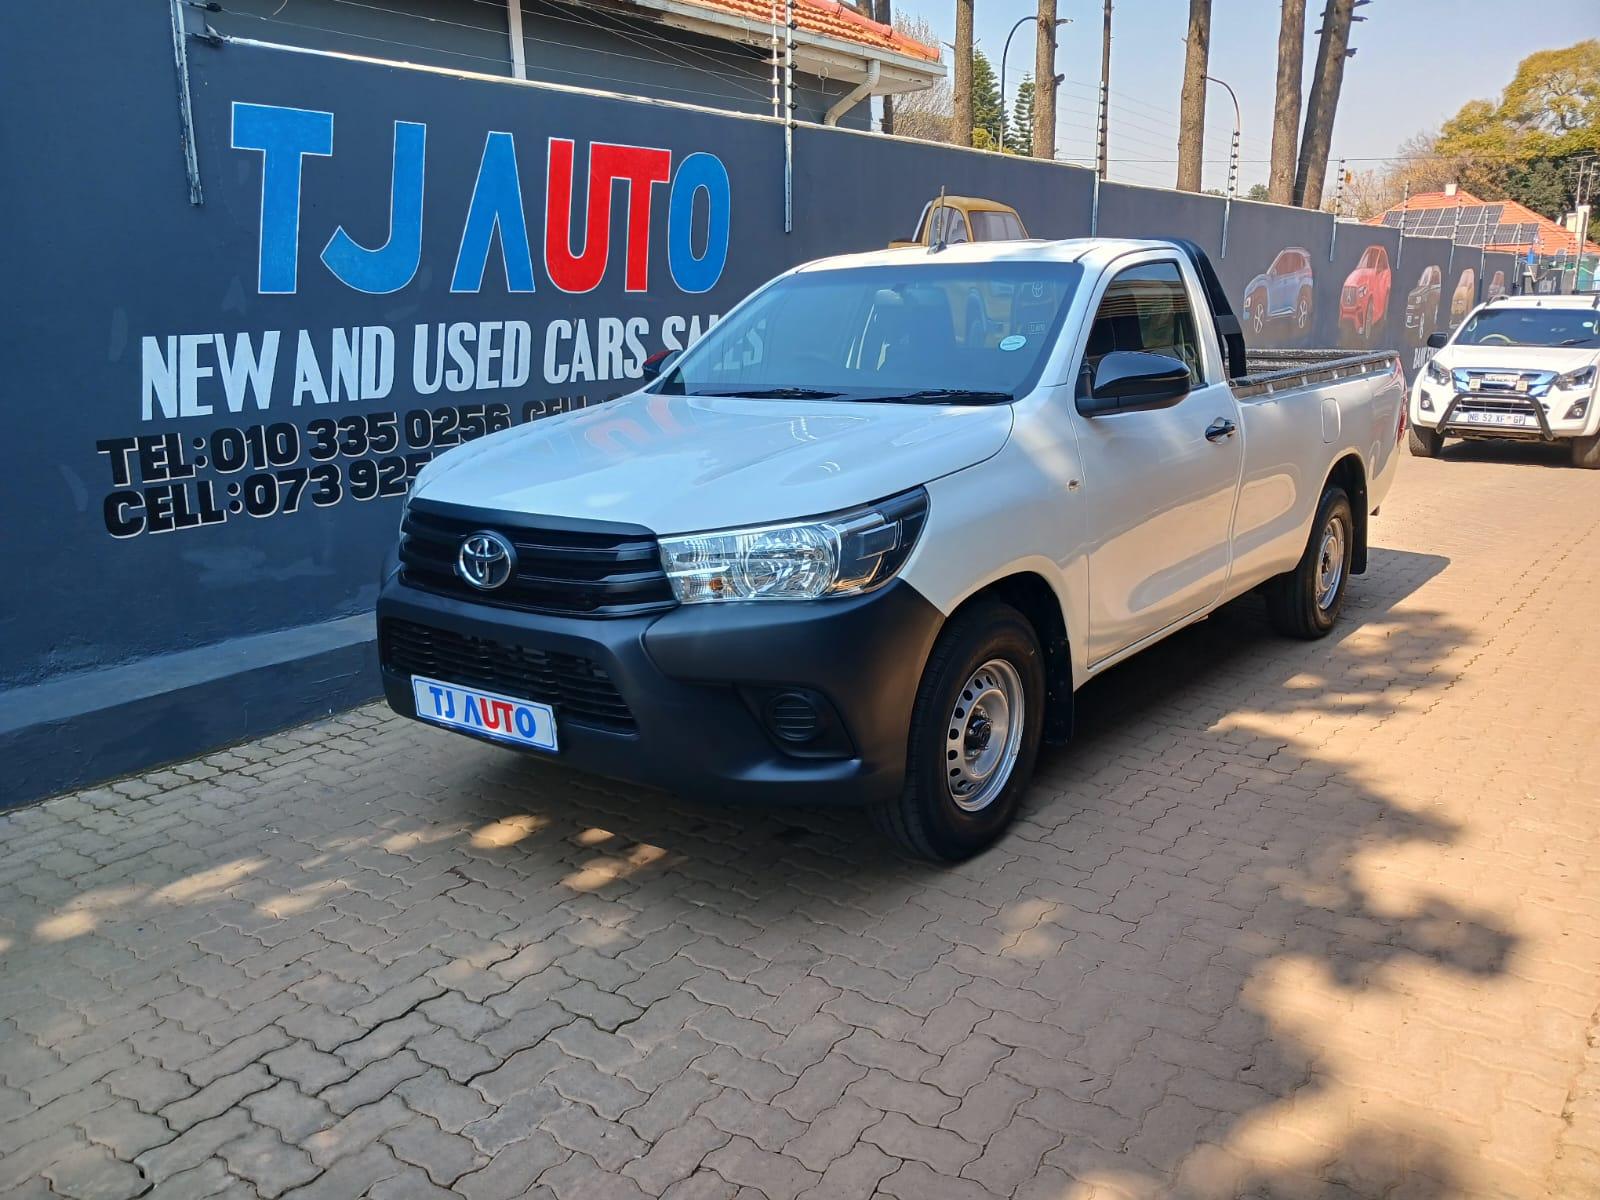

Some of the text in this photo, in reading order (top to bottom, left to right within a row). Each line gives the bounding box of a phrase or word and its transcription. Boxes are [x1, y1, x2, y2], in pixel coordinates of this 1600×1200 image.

[231, 101, 730, 294] TJ AUTO
[141, 330, 281, 421] NEW
[293, 325, 395, 406] AND
[413, 320, 531, 394] USED
[543, 317, 649, 384] CARS
[307, 411, 398, 461] 335
[404, 403, 511, 449] 0256
[429, 686, 536, 738] TJ AUTO
